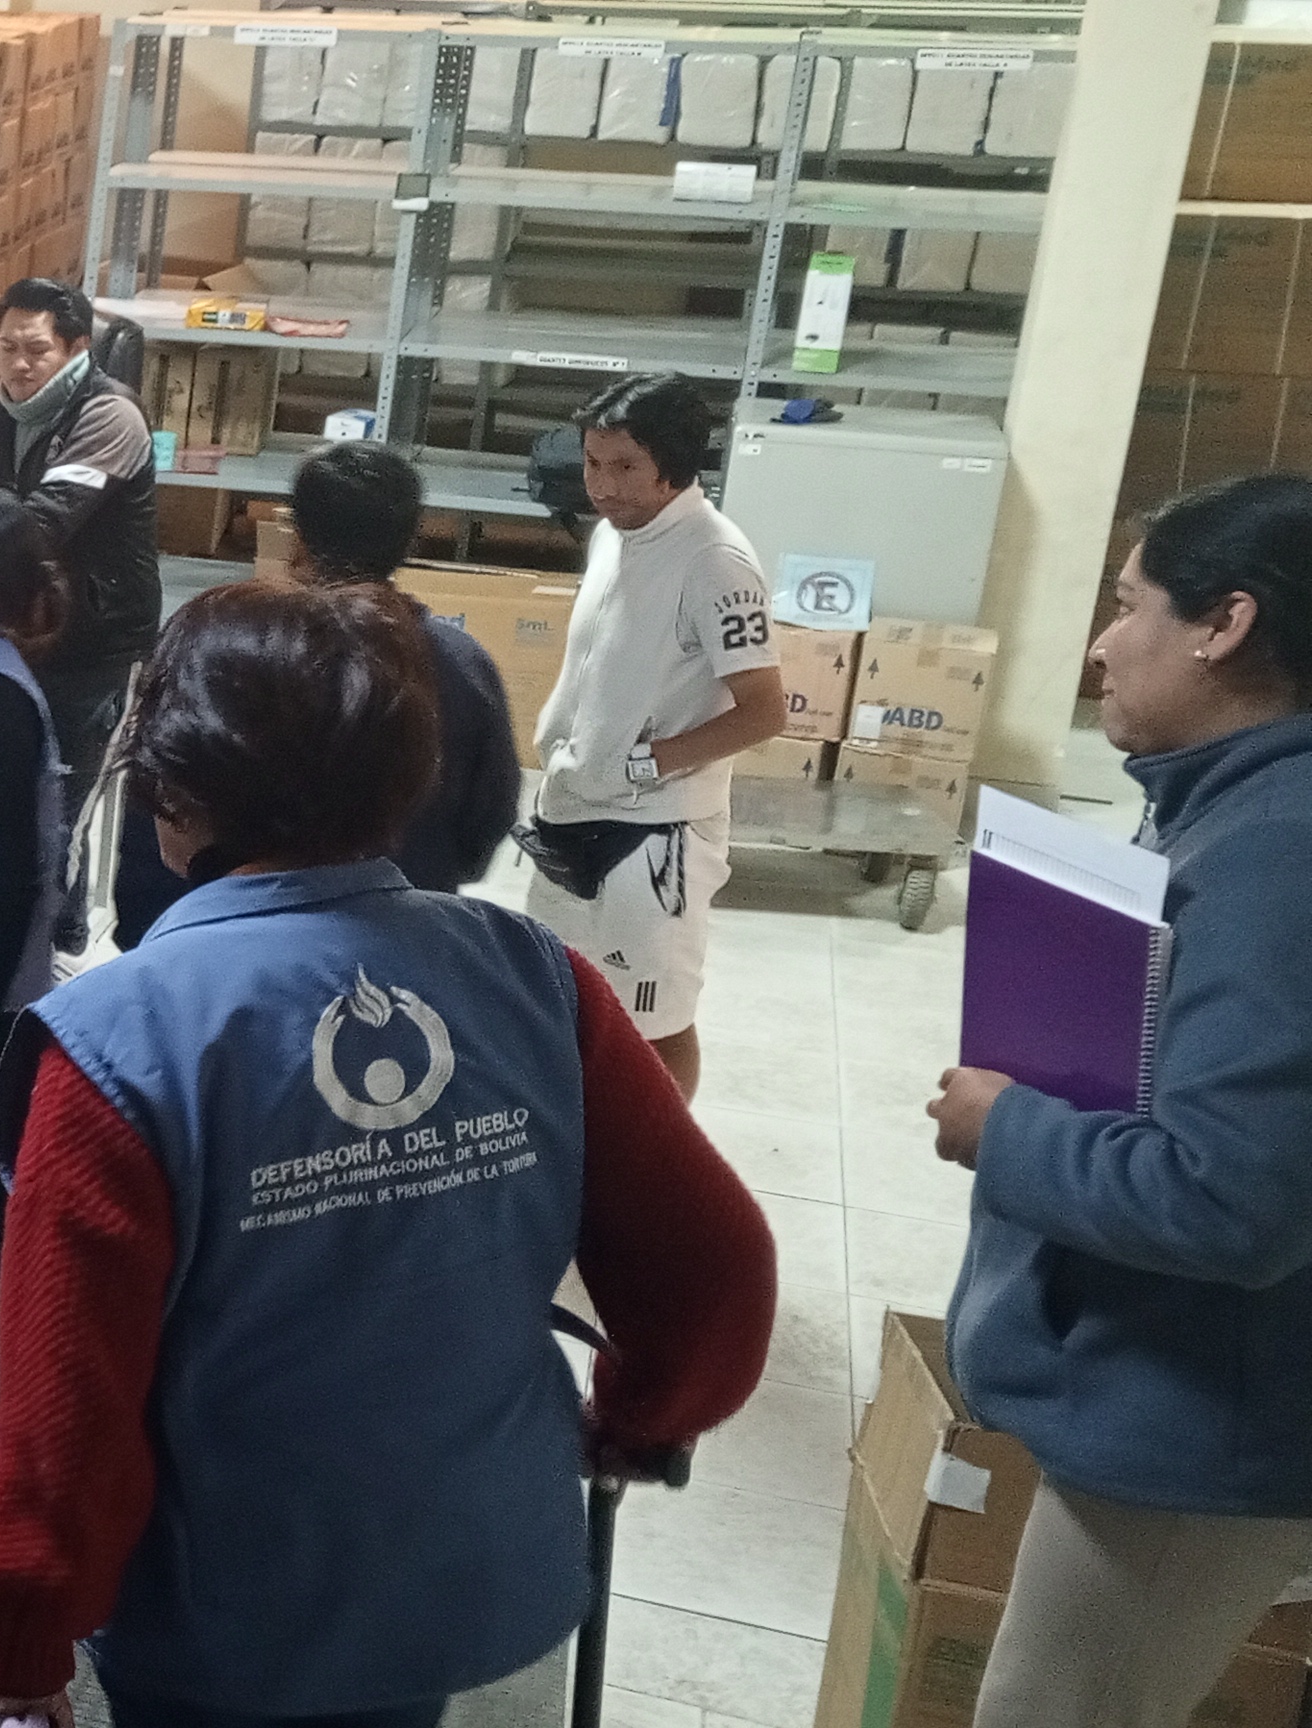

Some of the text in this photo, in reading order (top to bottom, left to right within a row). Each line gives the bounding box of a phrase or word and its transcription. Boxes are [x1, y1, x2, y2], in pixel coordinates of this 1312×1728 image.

[720, 610, 770, 651] 23
[403, 1126, 447, 1153] DEL
[454, 1107, 530, 1143] PUEBLO
[251, 1131, 530, 1206] ESTADO PLURINACIONAL DE BOLIVIA
[376, 1185, 394, 1204] DE
[466, 1167, 481, 1183] DE
[483, 1163, 500, 1180] LA
